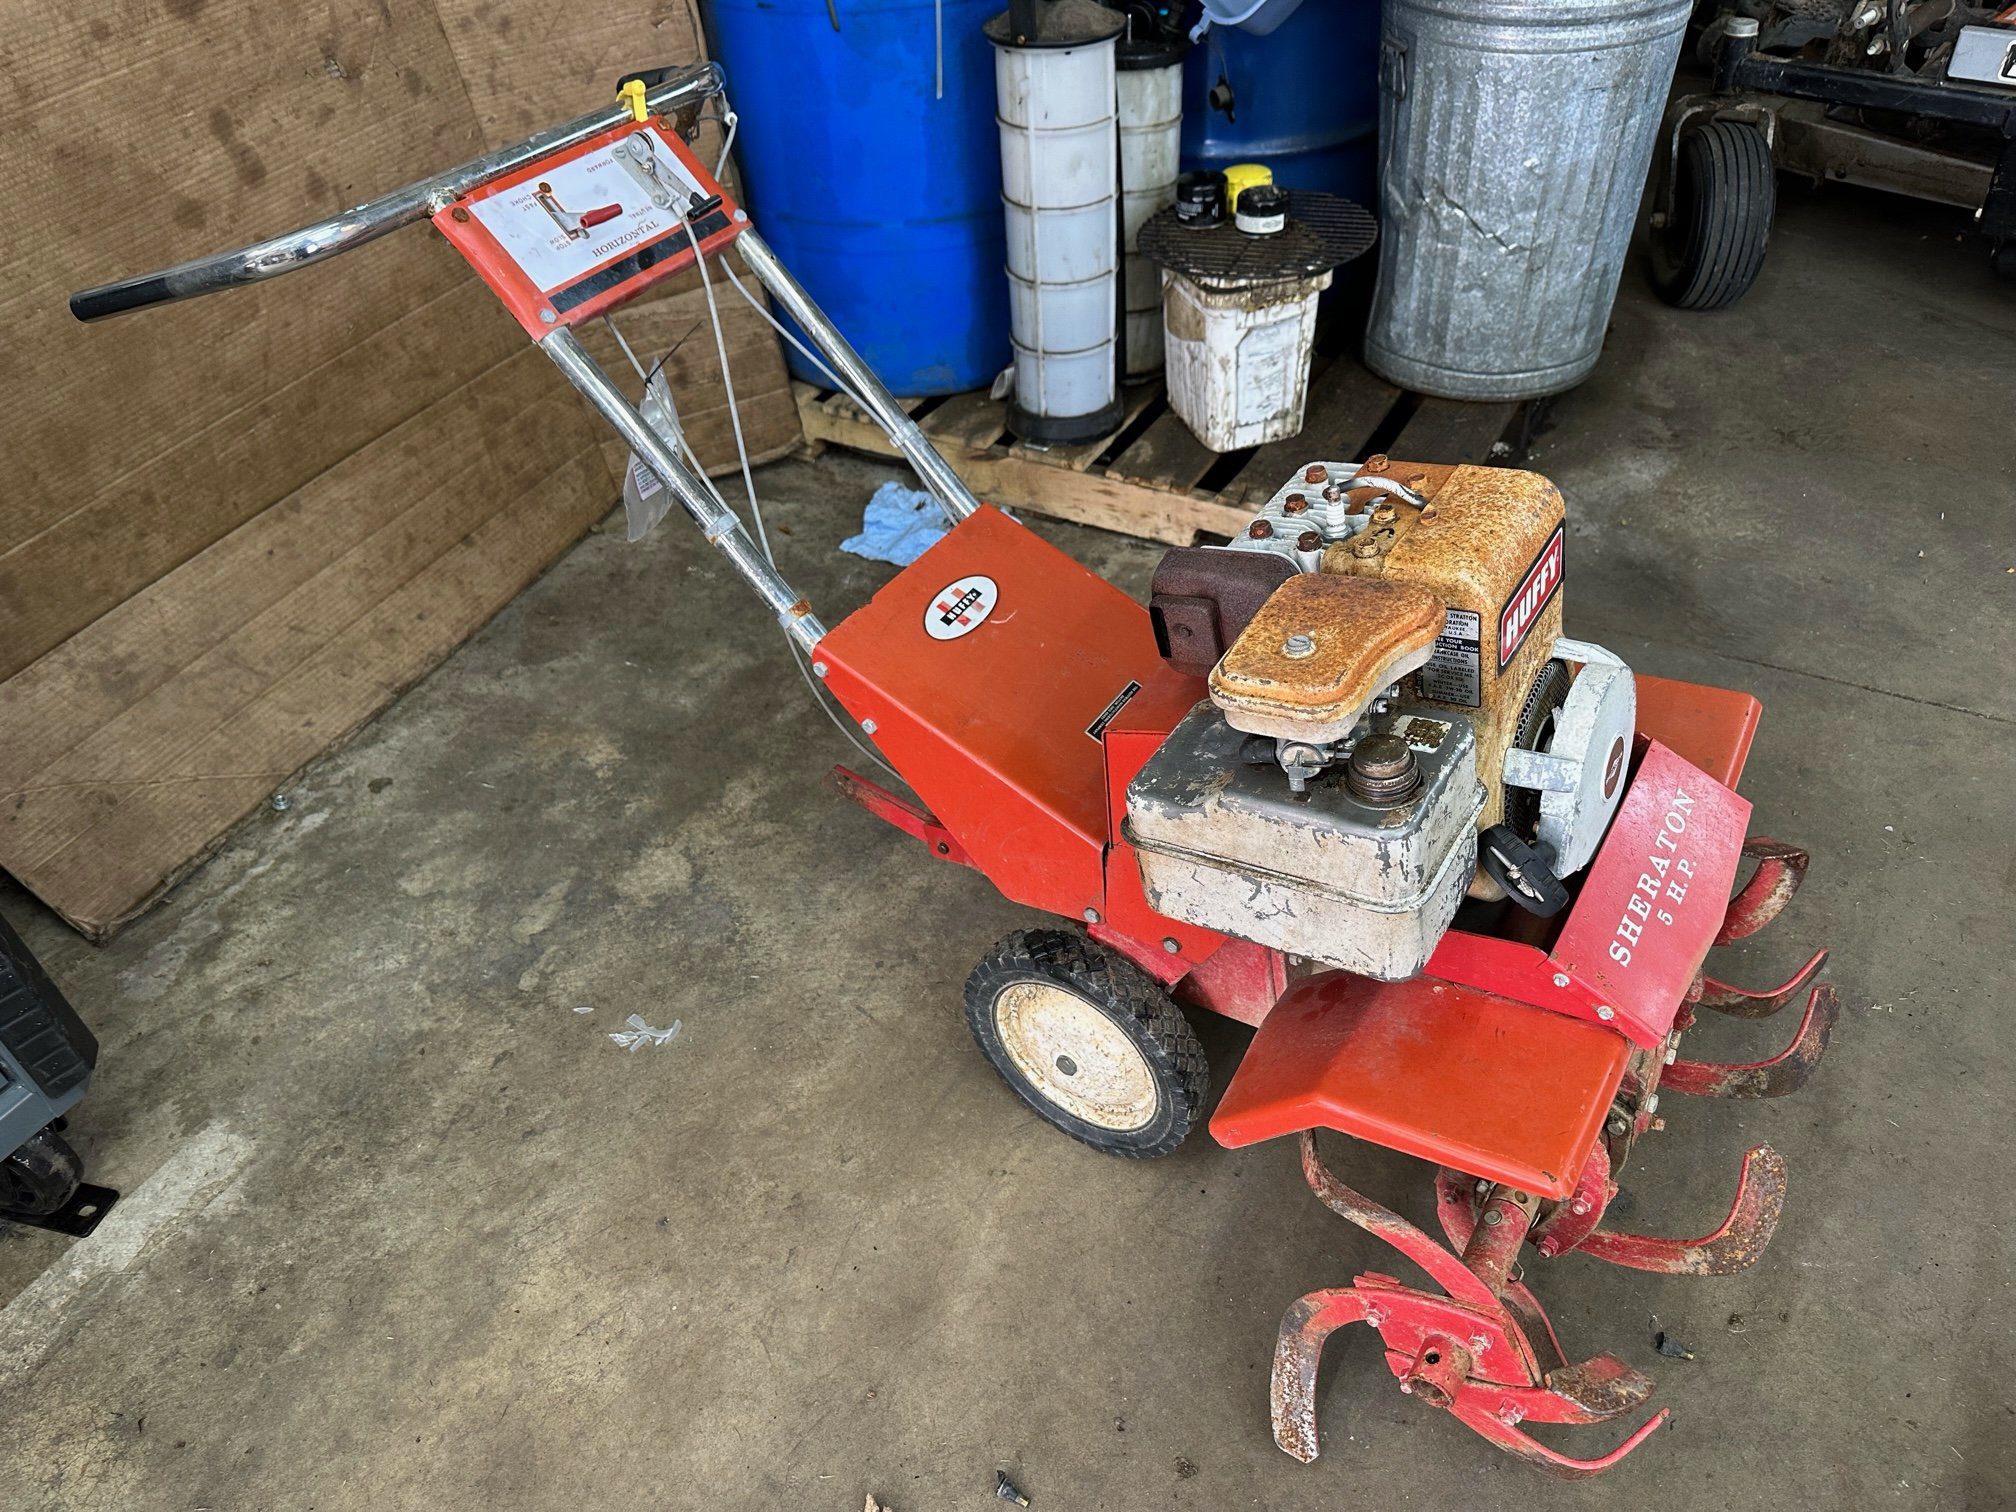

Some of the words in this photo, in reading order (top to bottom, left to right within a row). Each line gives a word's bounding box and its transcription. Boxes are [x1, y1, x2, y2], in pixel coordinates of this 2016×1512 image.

[511, 193, 532, 207] CHOKE
[522, 202, 538, 212] FAST
[591, 220, 660, 258] HORIZONTAL
[556, 240, 572, 251] STOP
[1505, 546, 1559, 650] HUFFY
[946, 591, 977, 620] HUFFY
[1450, 613, 1478, 621] STRATTON
[1445, 619, 1469, 627] ORATION
[1446, 637, 1463, 645] YOUR
[1460, 645, 1479, 653] BOOK
[1450, 665, 1475, 674] LABELED
[1608, 787, 1696, 968] SHERATON
[1656, 908, 1673, 926] 5
